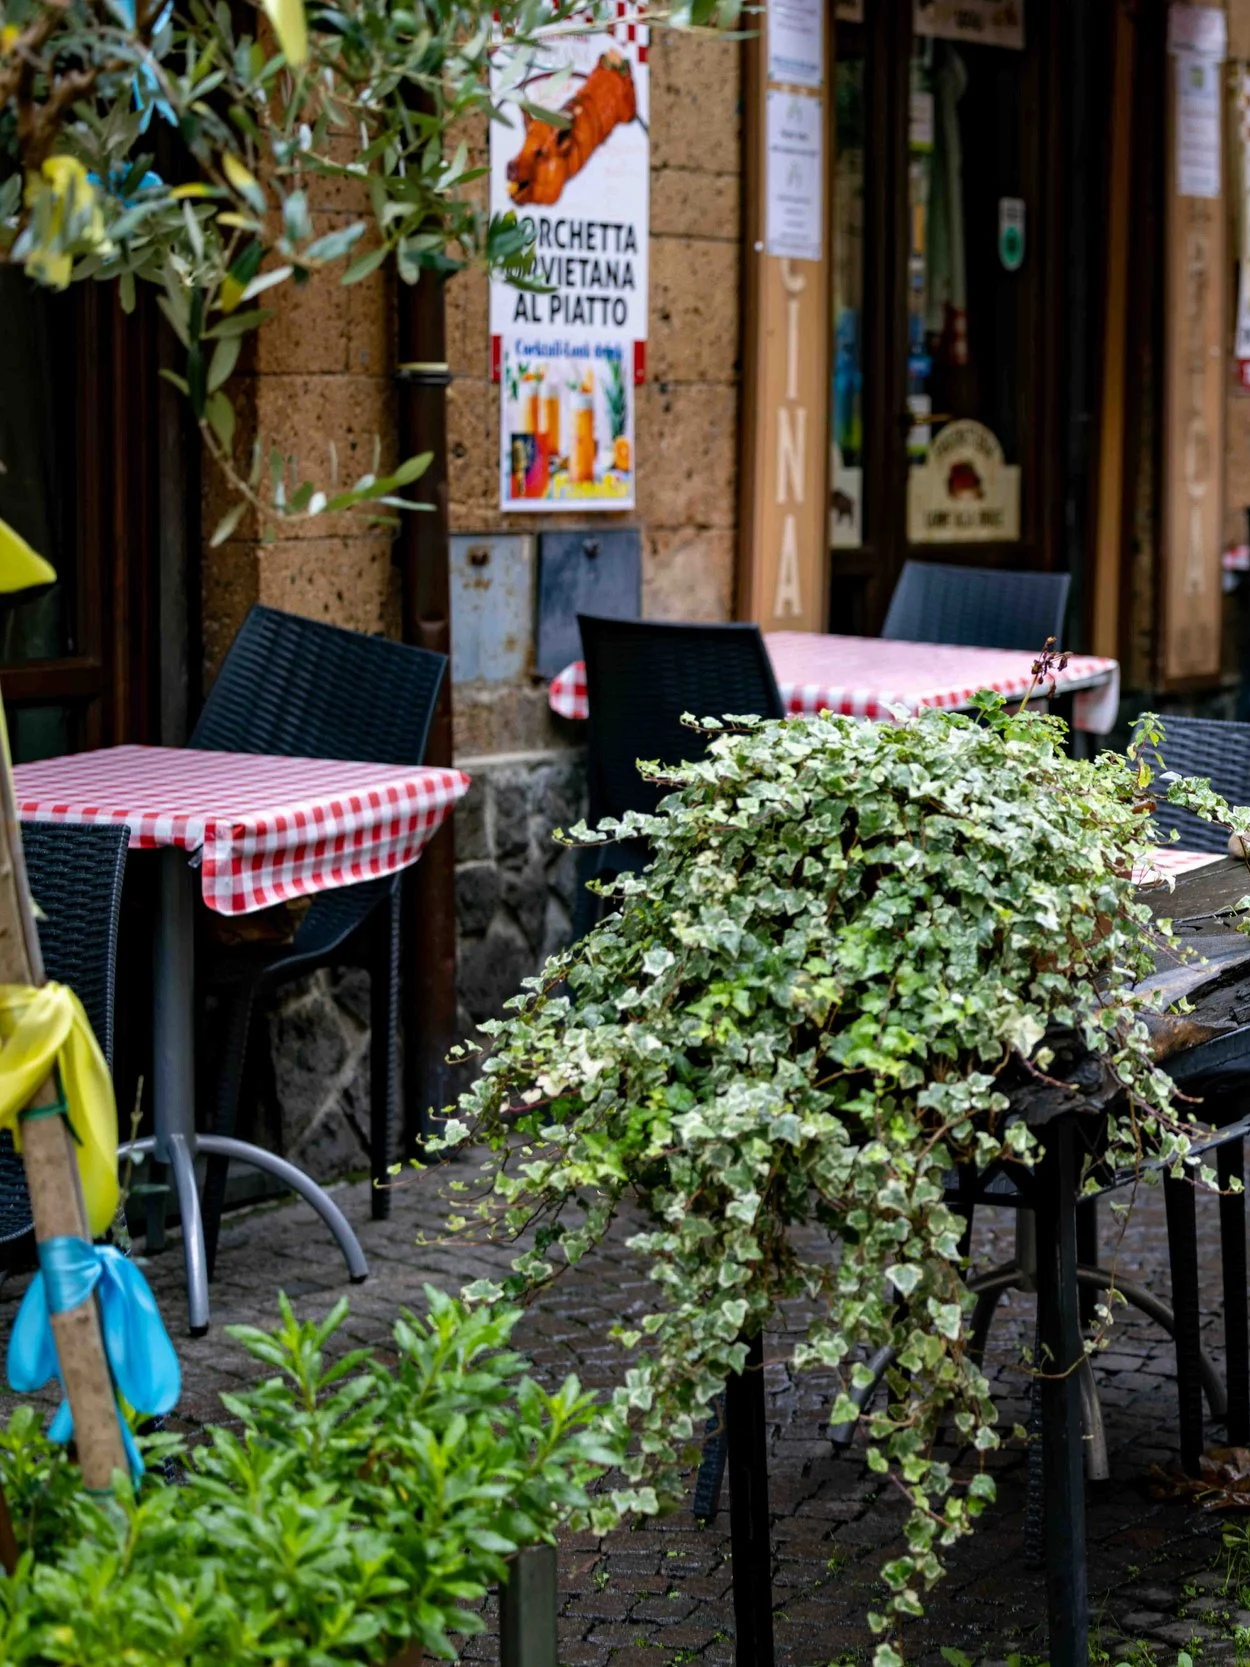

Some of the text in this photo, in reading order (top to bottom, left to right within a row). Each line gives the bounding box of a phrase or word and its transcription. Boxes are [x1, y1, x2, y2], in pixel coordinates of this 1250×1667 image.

[519, 216, 637, 253] ORCHETTA
[513, 292, 627, 327] AL PIATTO
